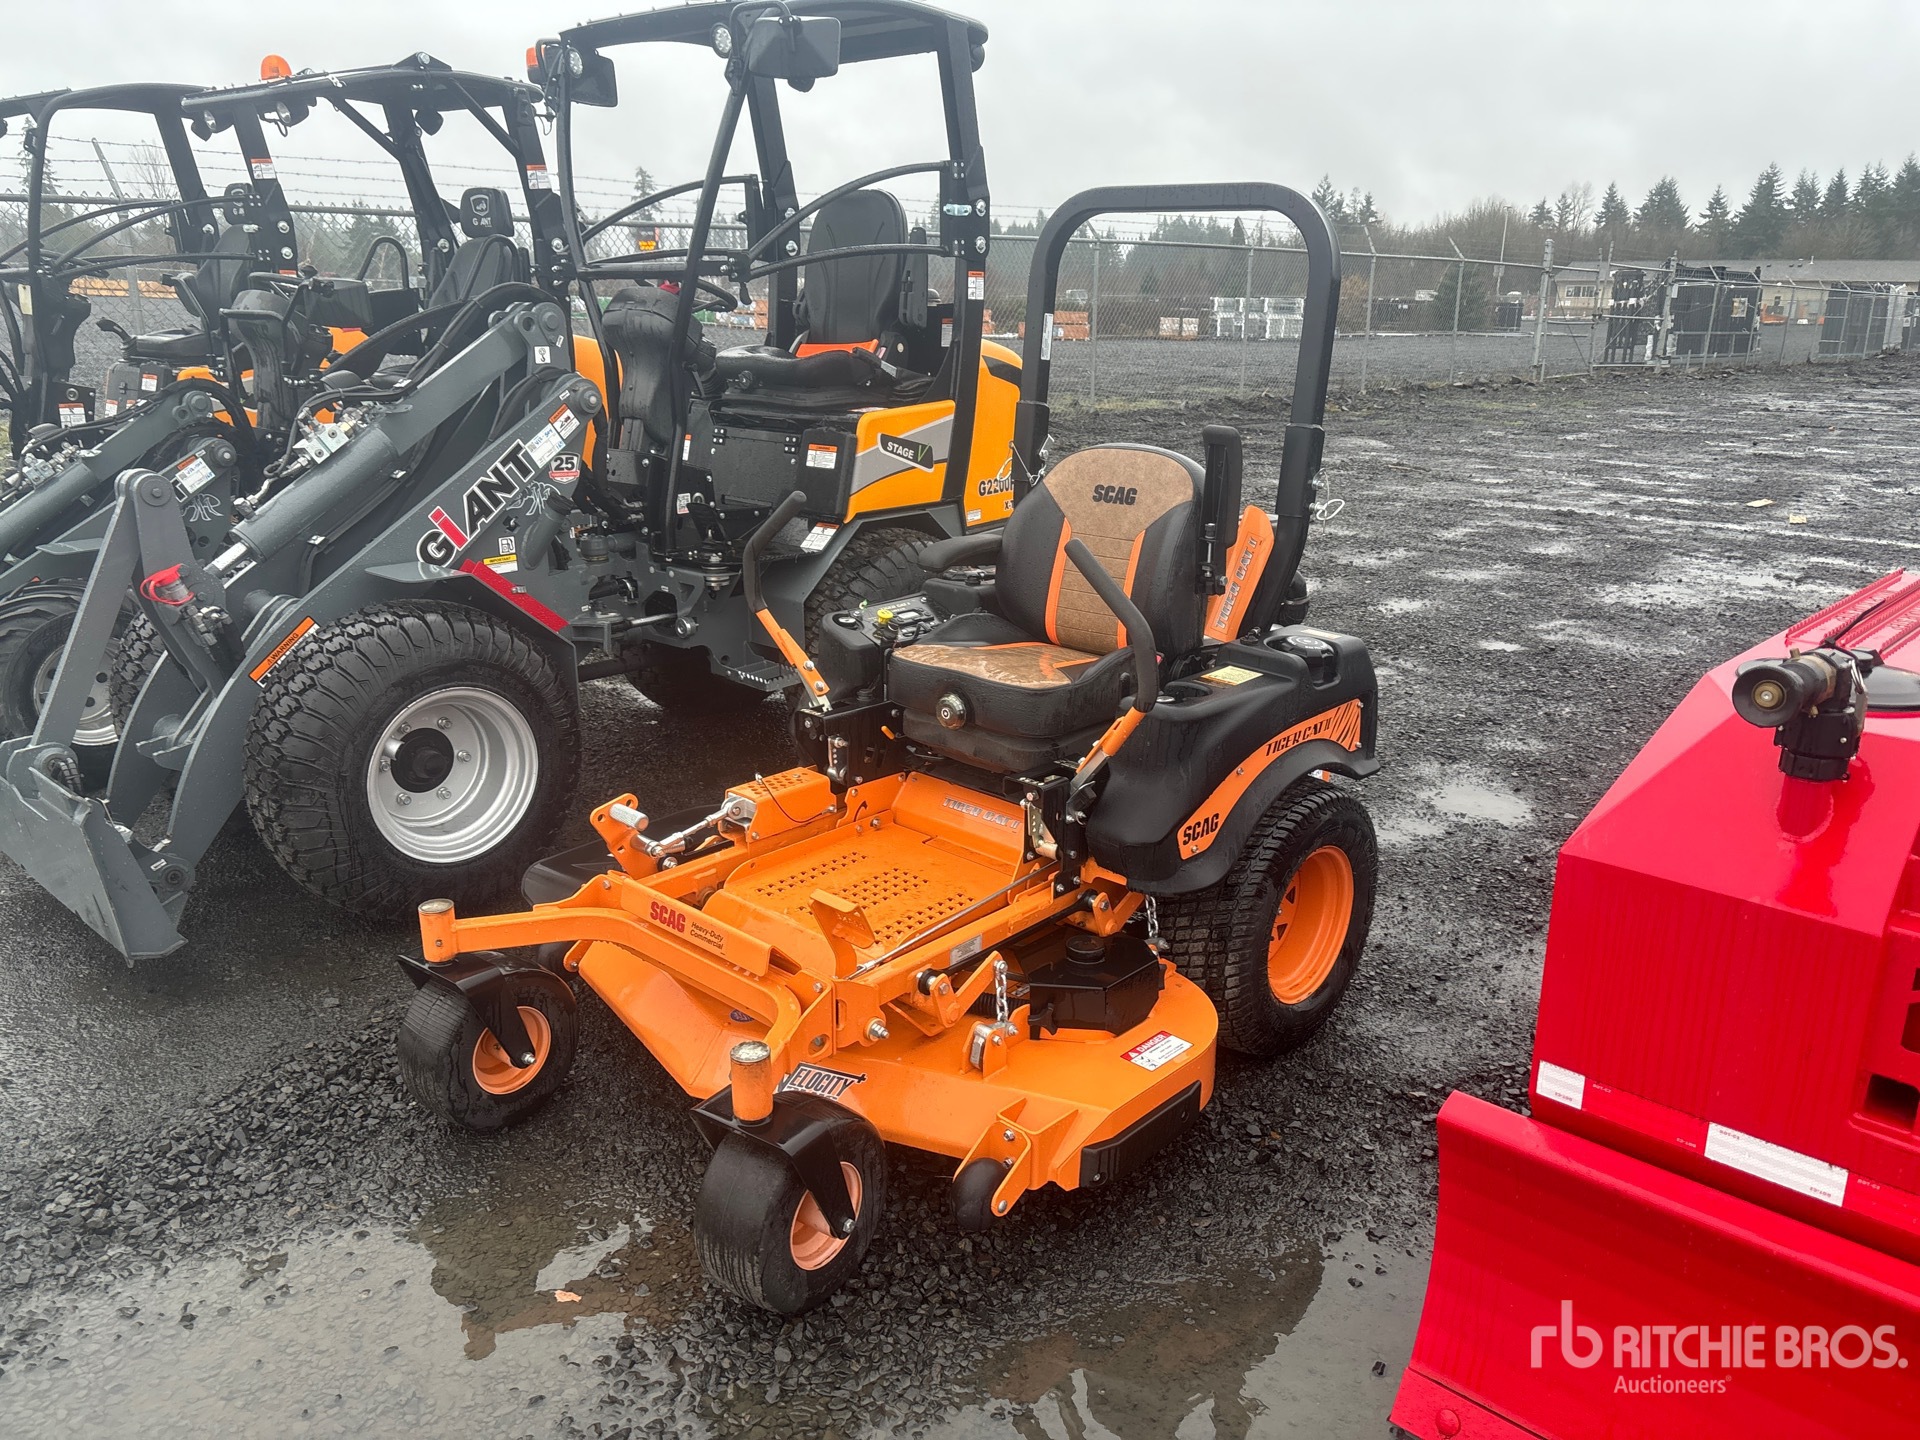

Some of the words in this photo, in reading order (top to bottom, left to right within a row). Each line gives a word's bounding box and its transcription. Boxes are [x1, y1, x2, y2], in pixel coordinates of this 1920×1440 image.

[553, 457, 575, 471] 25
[886, 441, 915, 460] STAGE
[917, 443, 931, 462] V
[1092, 484, 1138, 506] SCAG
[1216, 581, 1240, 629] TIGER
[1235, 547, 1254, 581] CAT
[270, 632, 299, 660] WARNING
[1265, 730, 1302, 757] TIGER
[1302, 721, 1325, 741] CAT
[942, 796, 983, 818] TIGER
[982, 810, 1011, 826] CAT
[1182, 812, 1220, 846] SCAG
[650, 901, 686, 933] SCAG
[690, 929, 724, 950] Commercial
[691, 921, 724, 943] Heavy-Duty
[1136, 1033, 1167, 1053] DANGER
